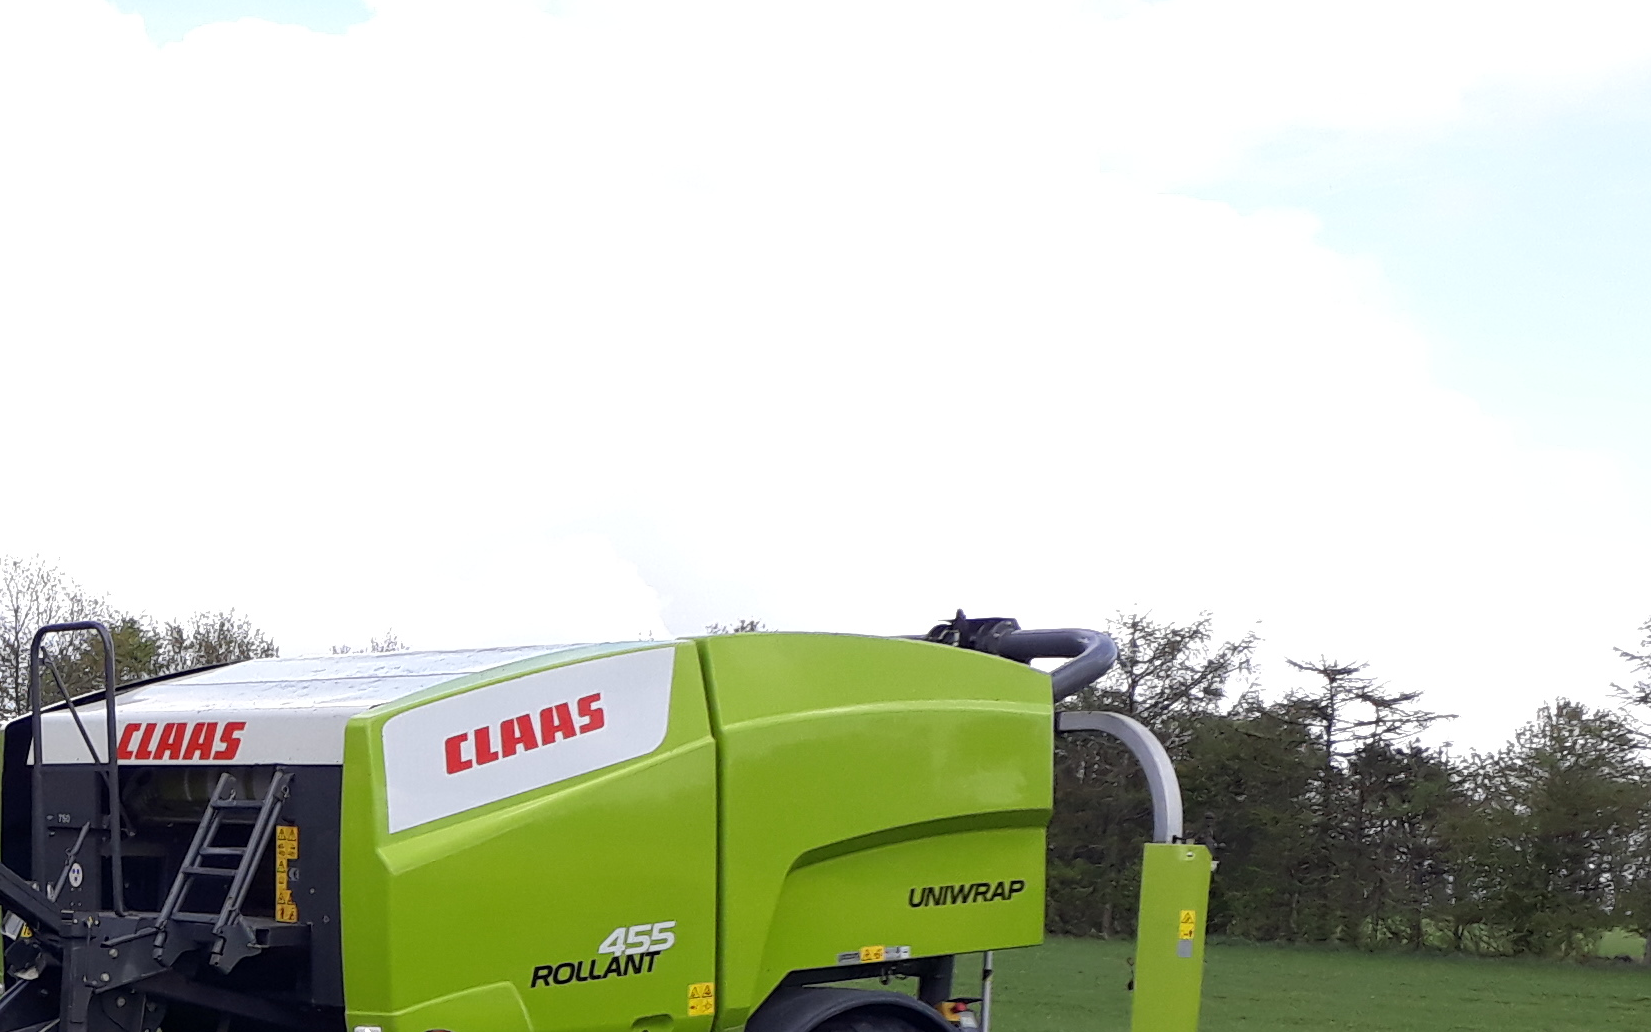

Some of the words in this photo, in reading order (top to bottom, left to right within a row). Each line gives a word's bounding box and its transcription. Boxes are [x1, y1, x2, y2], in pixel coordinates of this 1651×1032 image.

[116, 722, 247, 760] CLAAS
[445, 693, 605, 775] CLAAS
[908, 880, 1026, 908] UNIWRAP
[598, 920, 677, 957] 455
[530, 950, 662, 988] ROLLANT
